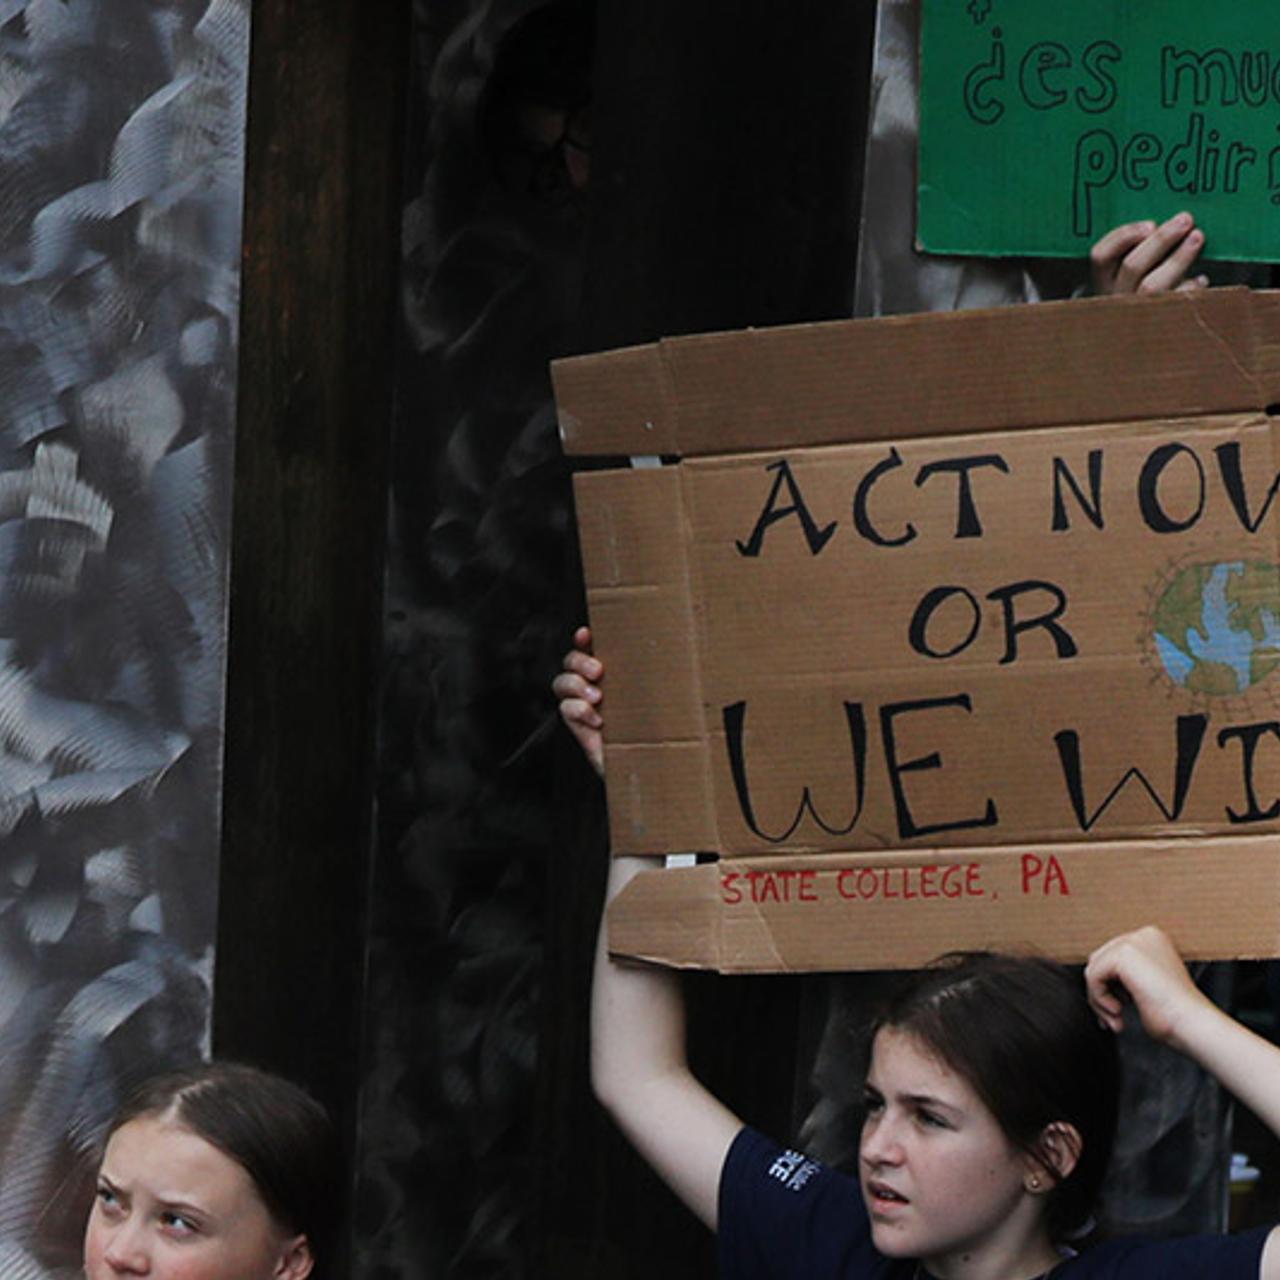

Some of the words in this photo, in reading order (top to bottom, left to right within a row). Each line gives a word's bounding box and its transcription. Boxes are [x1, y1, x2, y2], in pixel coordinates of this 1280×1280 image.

[736, 447, 1010, 557] ACT
[908, 580, 1078, 665] OR
[723, 694, 999, 843] WE
[719, 871, 820, 905] STATE
[1021, 853, 1070, 895] PA
